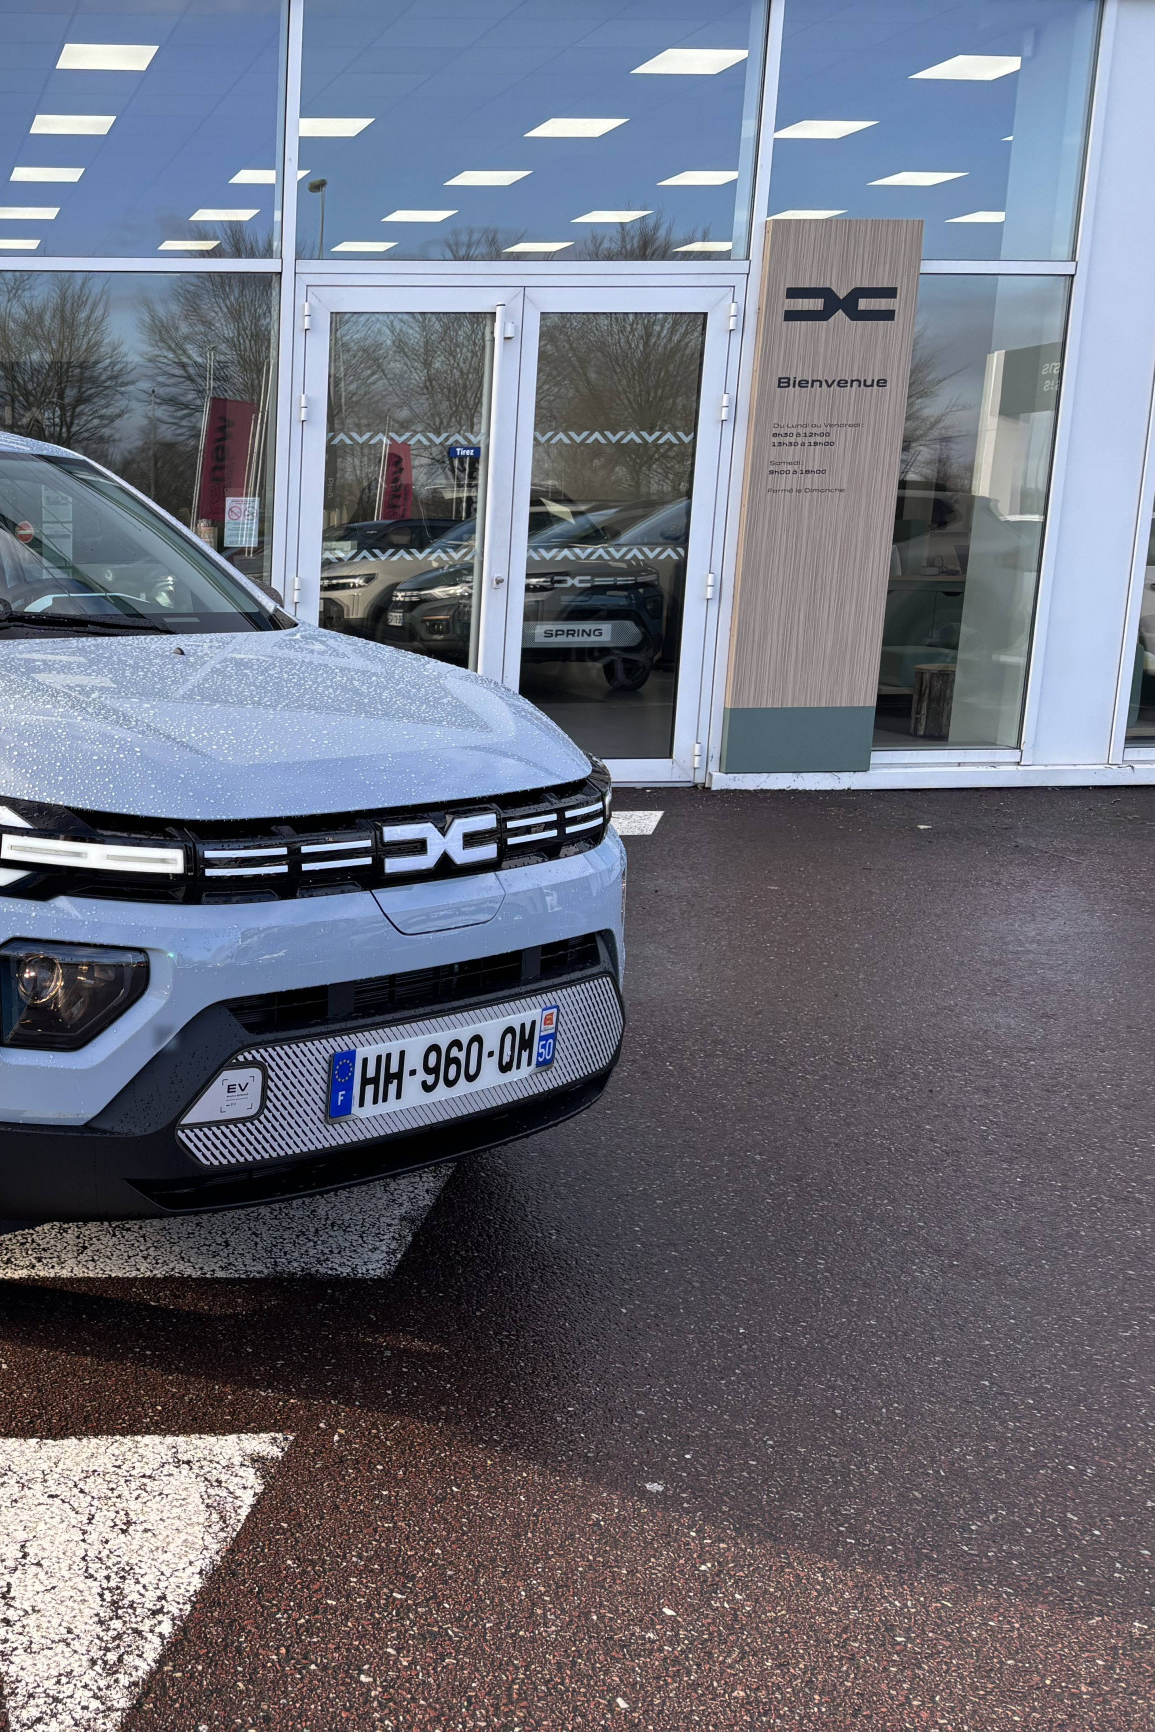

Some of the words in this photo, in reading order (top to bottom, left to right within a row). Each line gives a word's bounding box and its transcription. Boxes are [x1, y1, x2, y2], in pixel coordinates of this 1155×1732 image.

[777, 376, 888, 389] Bienvenue
[455, 447, 475, 456] Tirez
[543, 628, 603, 638] SPRING
[538, 1038, 554, 1062] 50
[358, 1019, 537, 1109] HH-960-QM
[226, 1082, 249, 1094] EV
[337, 1091, 346, 1106] F
